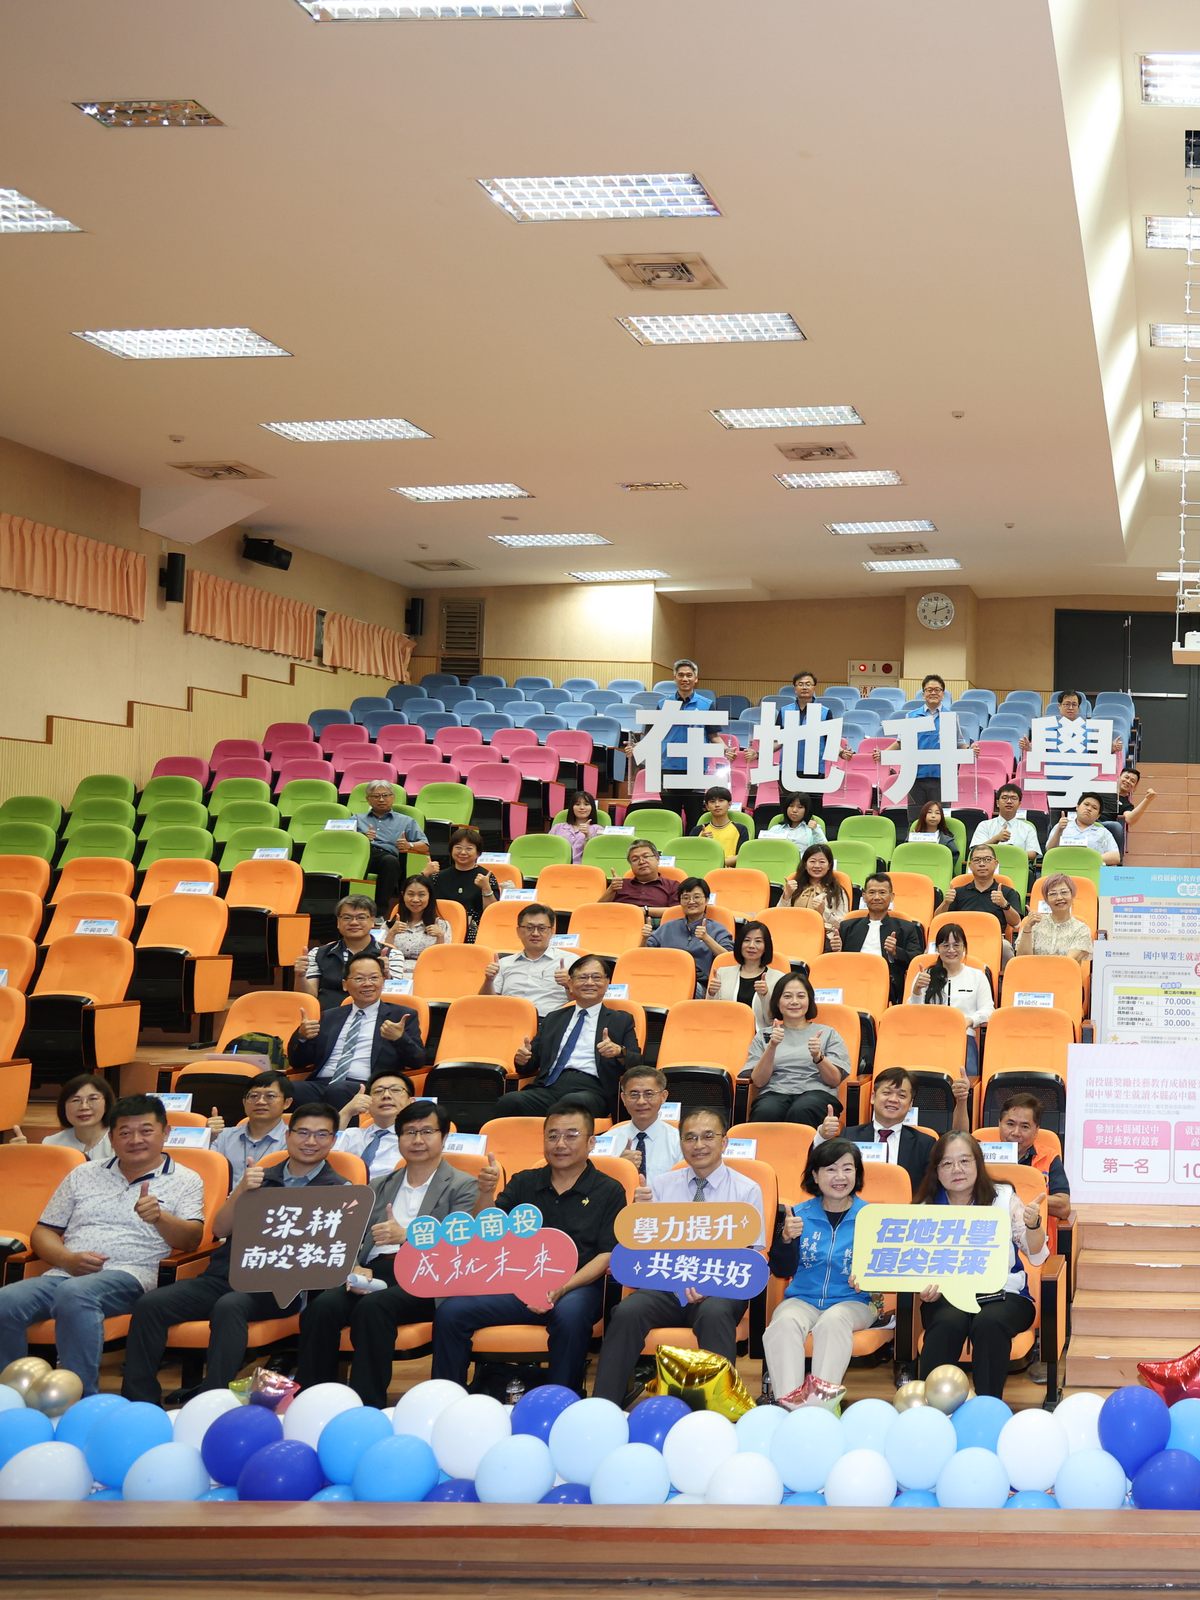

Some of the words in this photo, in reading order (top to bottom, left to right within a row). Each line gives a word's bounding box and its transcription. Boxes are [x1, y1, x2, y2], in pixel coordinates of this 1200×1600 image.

[633, 700, 1118, 808] 在地升學
[1103, 1158, 1149, 1174] 第一名
[262, 1205, 342, 1238] 深耕
[412, 1209, 538, 1247] 留在南投
[633, 1215, 738, 1244] 學力提升
[876, 1218, 999, 1245] 在地升學
[241, 1240, 347, 1270] 南投教育
[411, 1242, 566, 1285] 成就未來
[647, 1251, 752, 1288] 共榮共好
[869, 1247, 992, 1275] 頂尖未來
